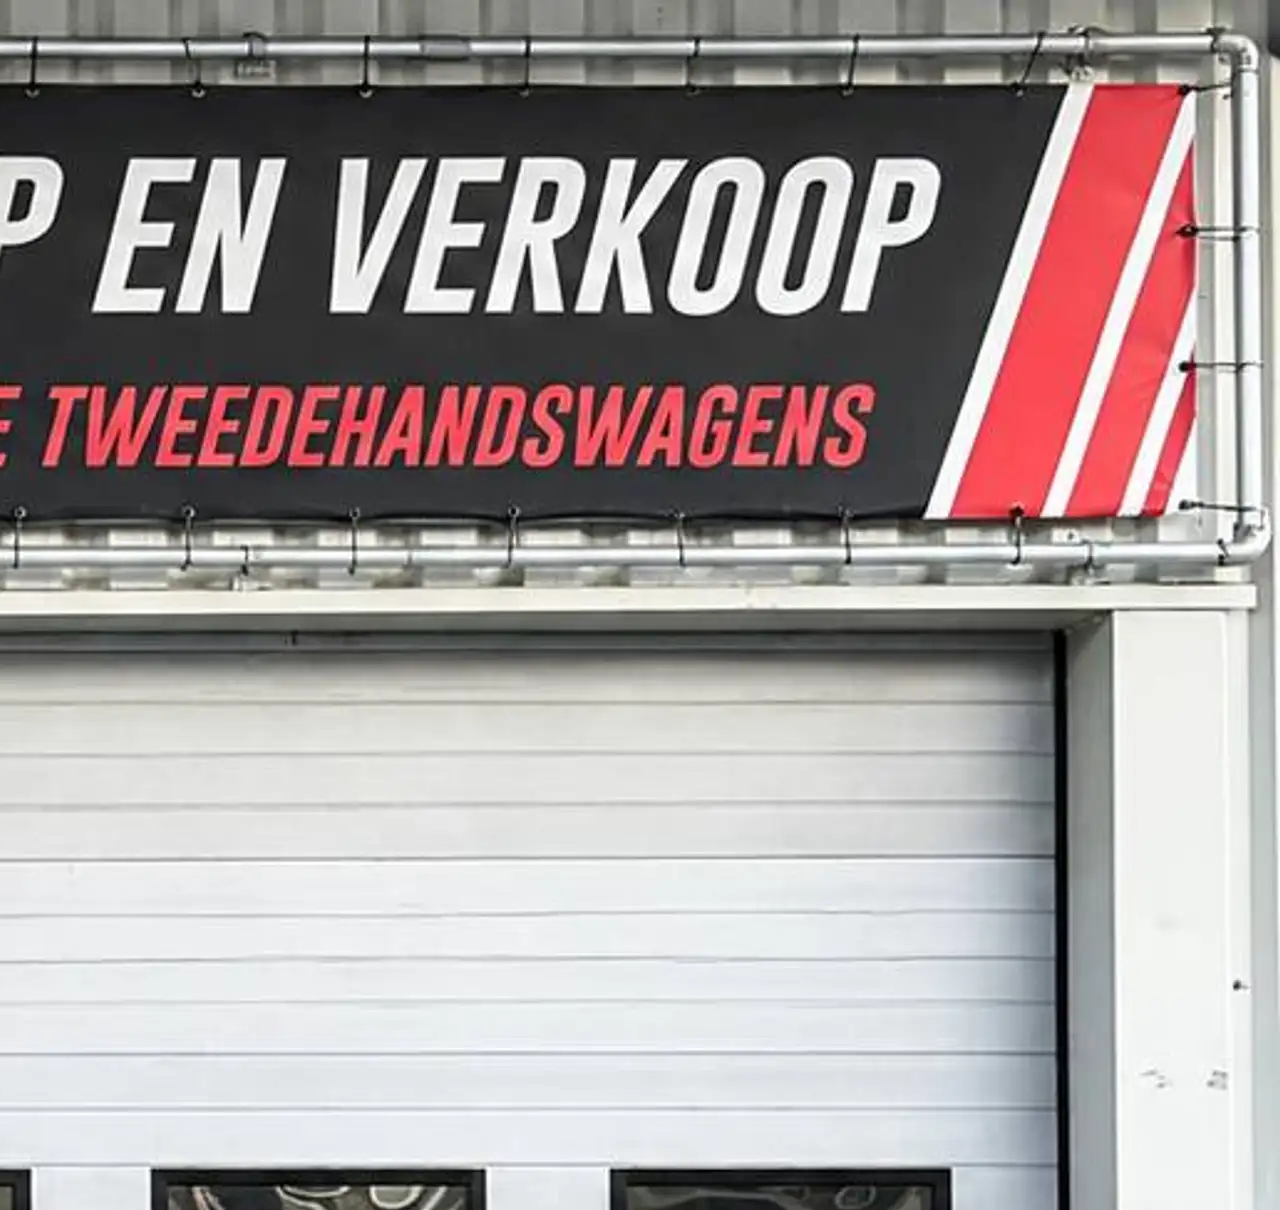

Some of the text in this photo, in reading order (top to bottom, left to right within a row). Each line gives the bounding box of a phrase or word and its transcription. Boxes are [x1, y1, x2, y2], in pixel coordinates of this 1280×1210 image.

[91, 157, 287, 314] EN
[328, 156, 941, 316] VERKOOP
[42, 383, 876, 469] TWEEDEHANDSWAGENS
